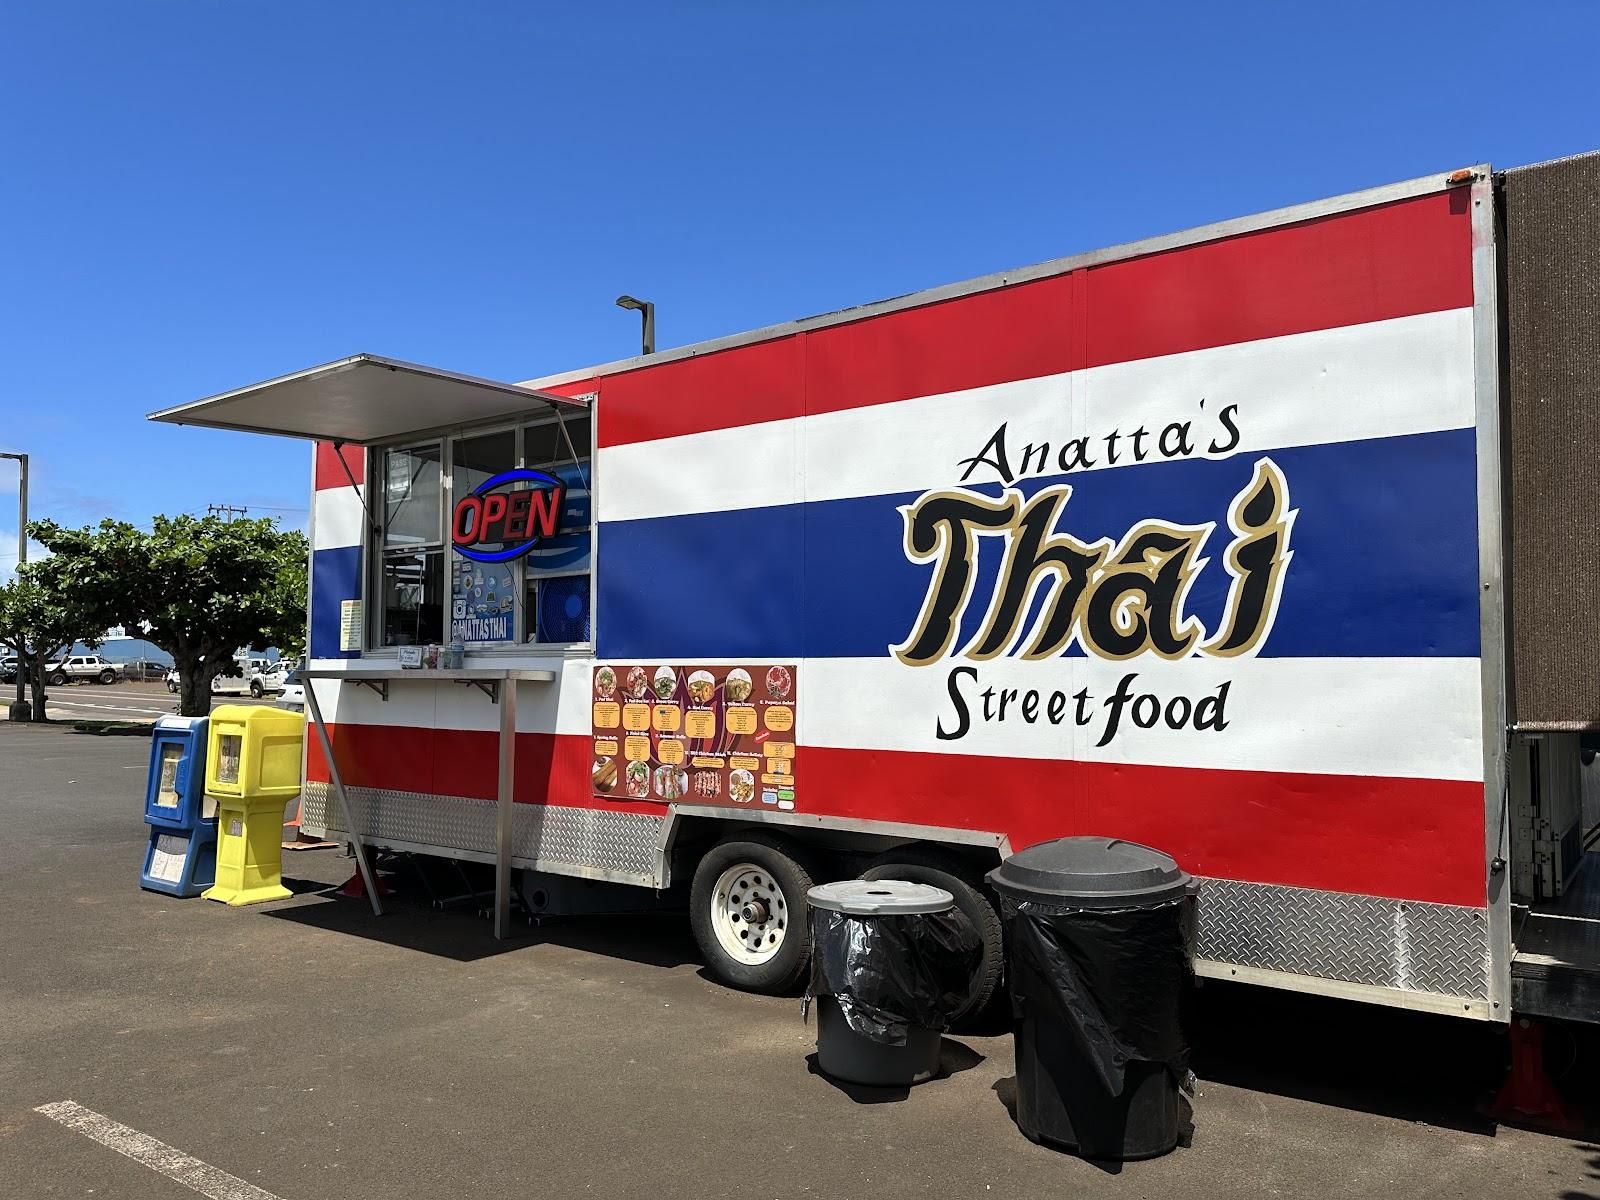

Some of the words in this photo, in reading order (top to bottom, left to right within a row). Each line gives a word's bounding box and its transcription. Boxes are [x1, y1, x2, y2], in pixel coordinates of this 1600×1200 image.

[956, 398, 1240, 484] Anatta's
[452, 487, 561, 544] OPEN
[890, 458, 1297, 667] Thai
